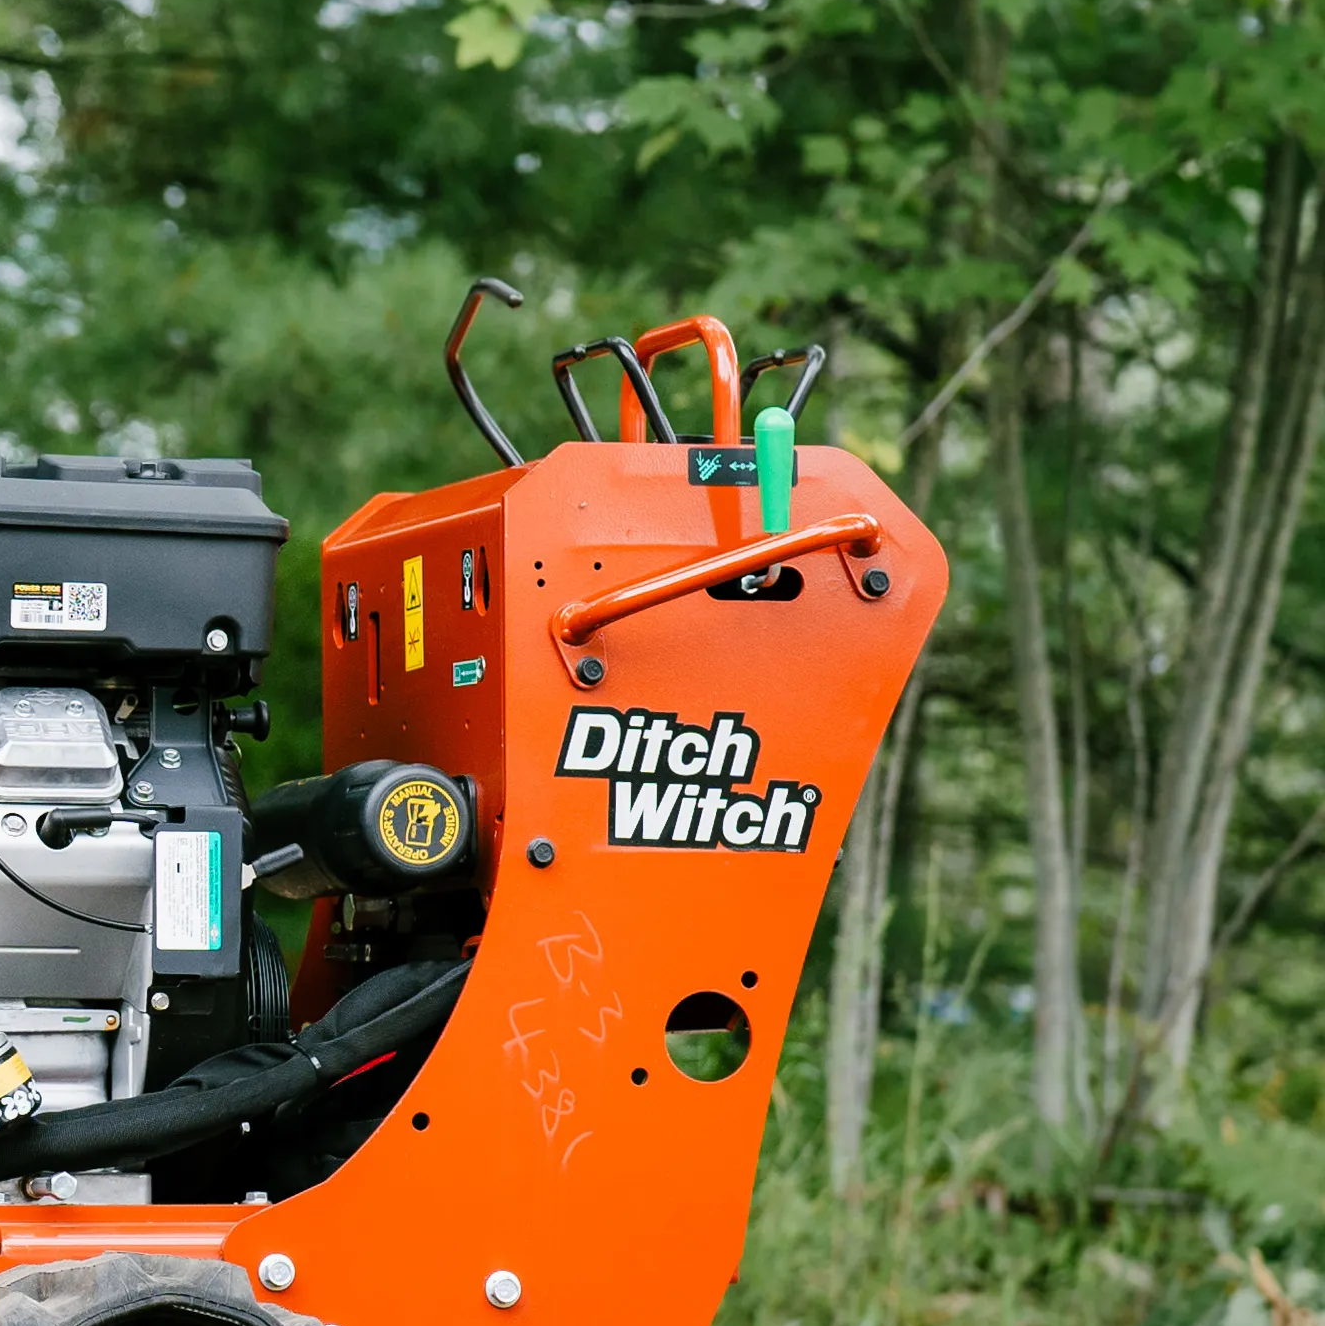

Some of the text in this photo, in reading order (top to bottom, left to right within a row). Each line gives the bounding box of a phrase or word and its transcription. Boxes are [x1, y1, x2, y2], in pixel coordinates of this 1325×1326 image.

[563, 712, 753, 777] Ditch
[383, 785, 434, 860] OPERATOR'S MANUAL
[439, 805, 456, 847] INSIDE
